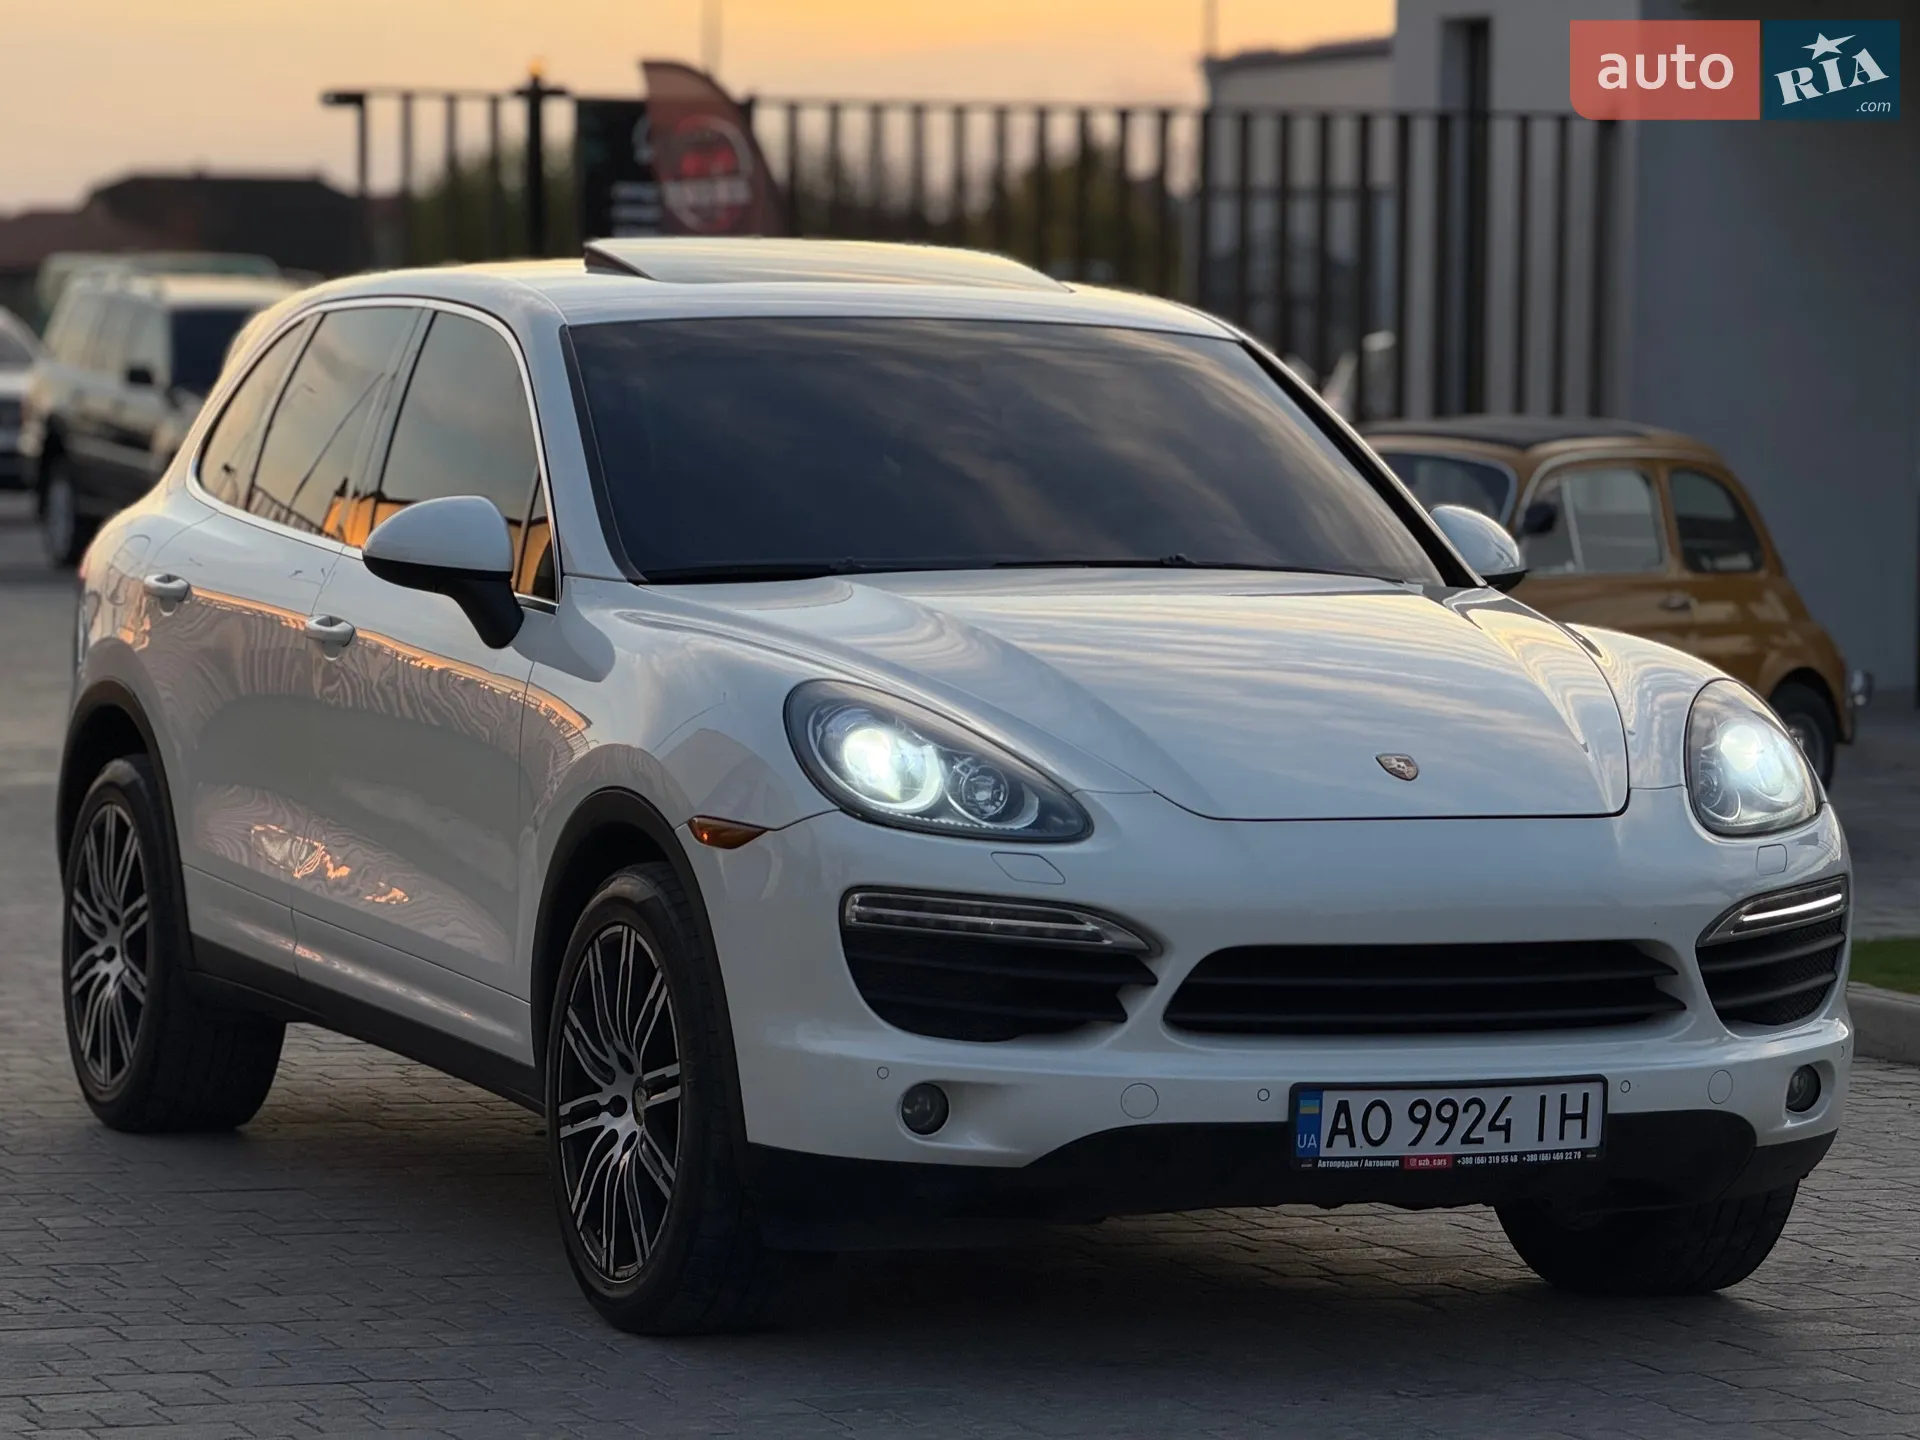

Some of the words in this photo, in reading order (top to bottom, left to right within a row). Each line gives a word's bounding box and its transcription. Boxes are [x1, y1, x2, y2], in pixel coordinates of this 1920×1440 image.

[1326, 1098, 1392, 1148] AO
[1408, 1096, 1512, 1147] 9924
[1538, 1092, 1589, 1142] IH
[1297, 1134, 1317, 1149] UA
